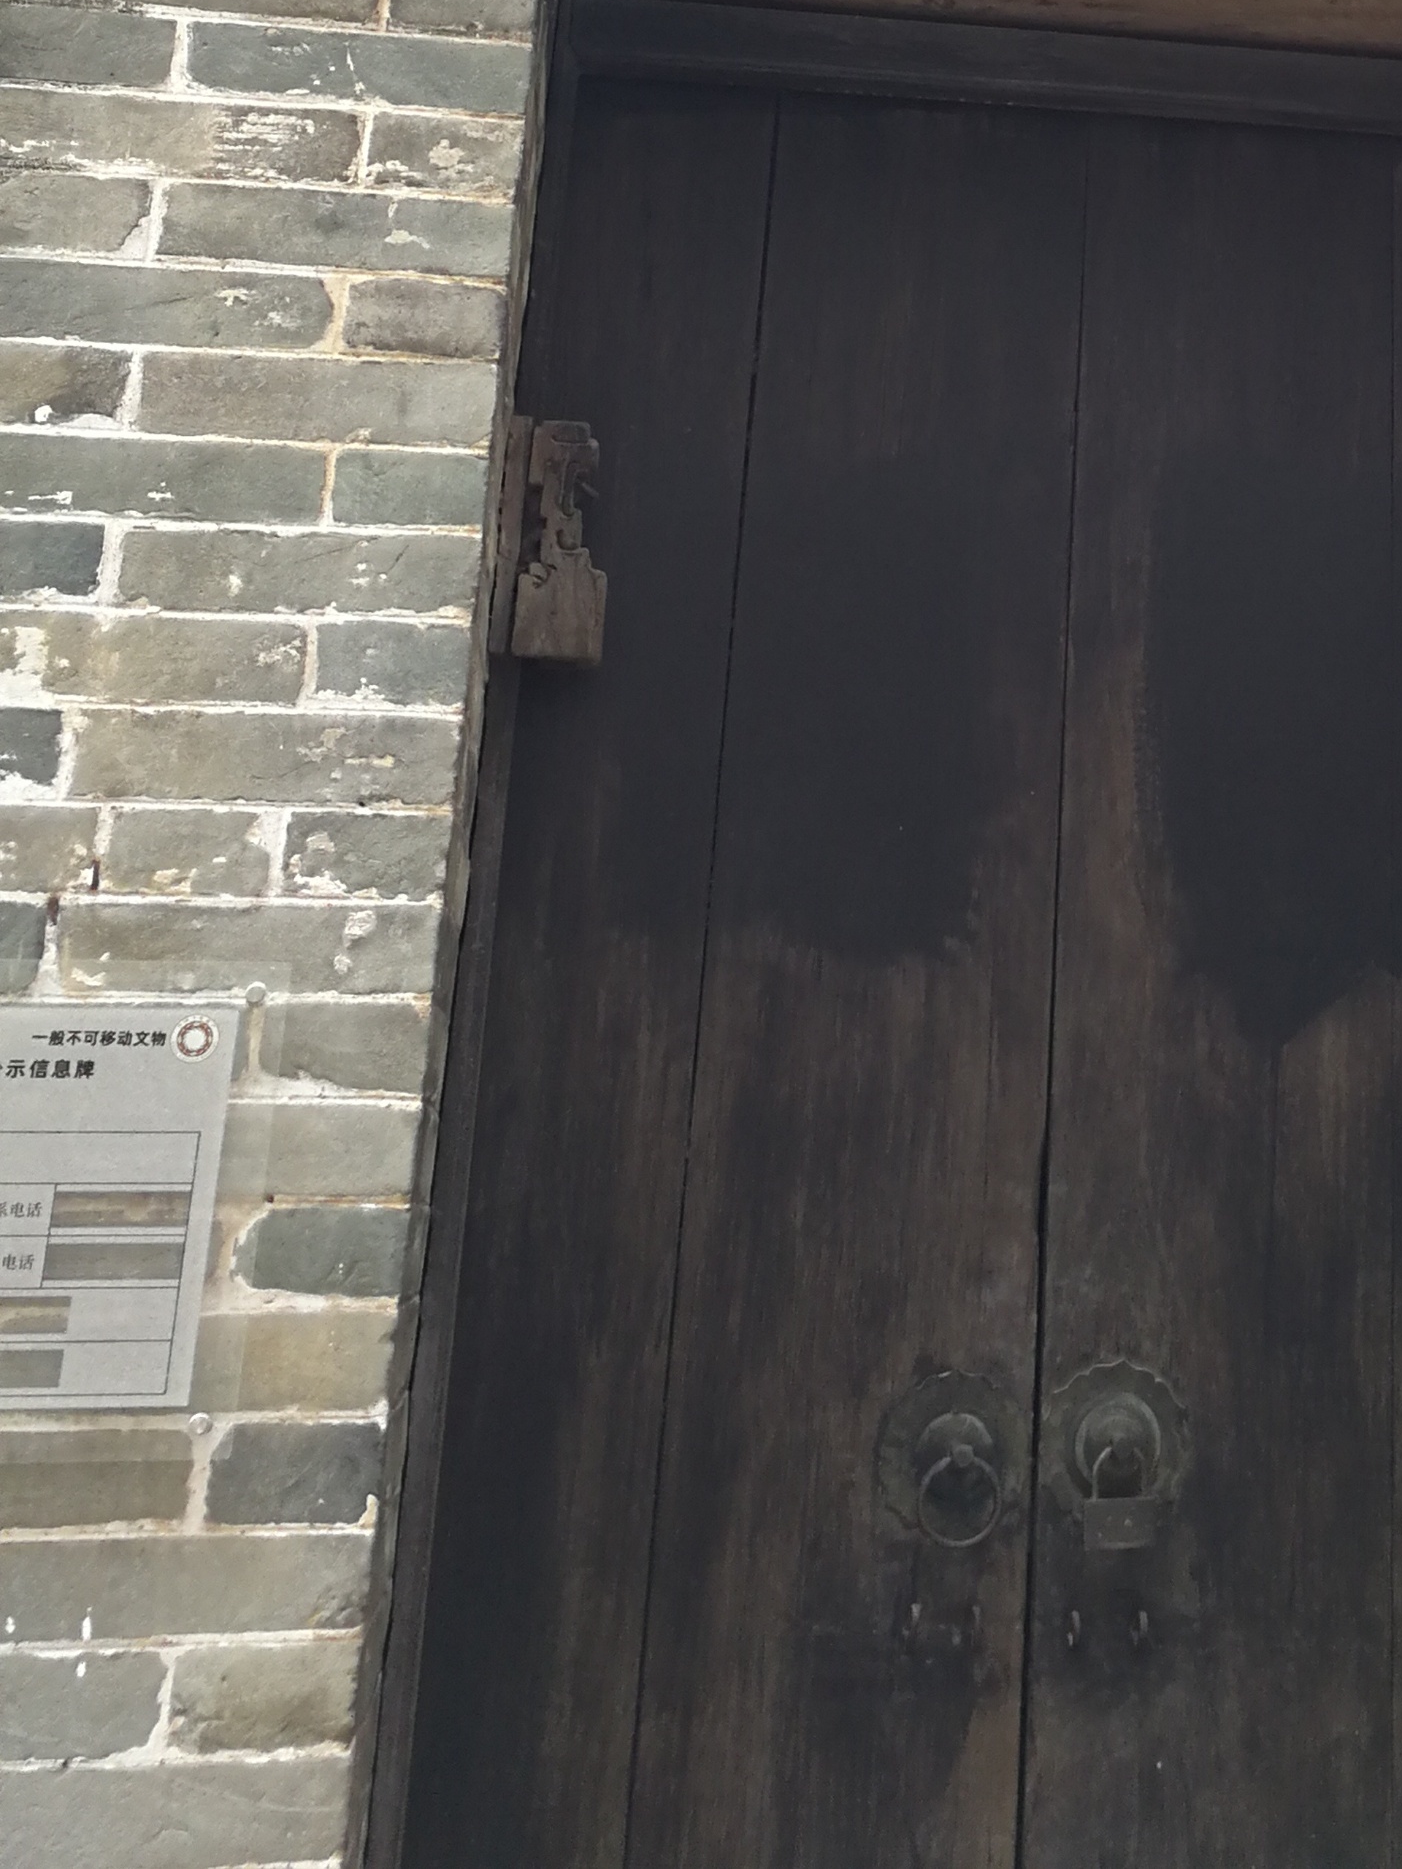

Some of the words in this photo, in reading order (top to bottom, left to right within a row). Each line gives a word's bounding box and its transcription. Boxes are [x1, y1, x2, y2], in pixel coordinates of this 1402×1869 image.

[32, 1030, 167, 1047] 一般不可移动文物
[0, 1059, 95, 1079] 示信息牌
[2, 1254, 35, 1270] 电话
